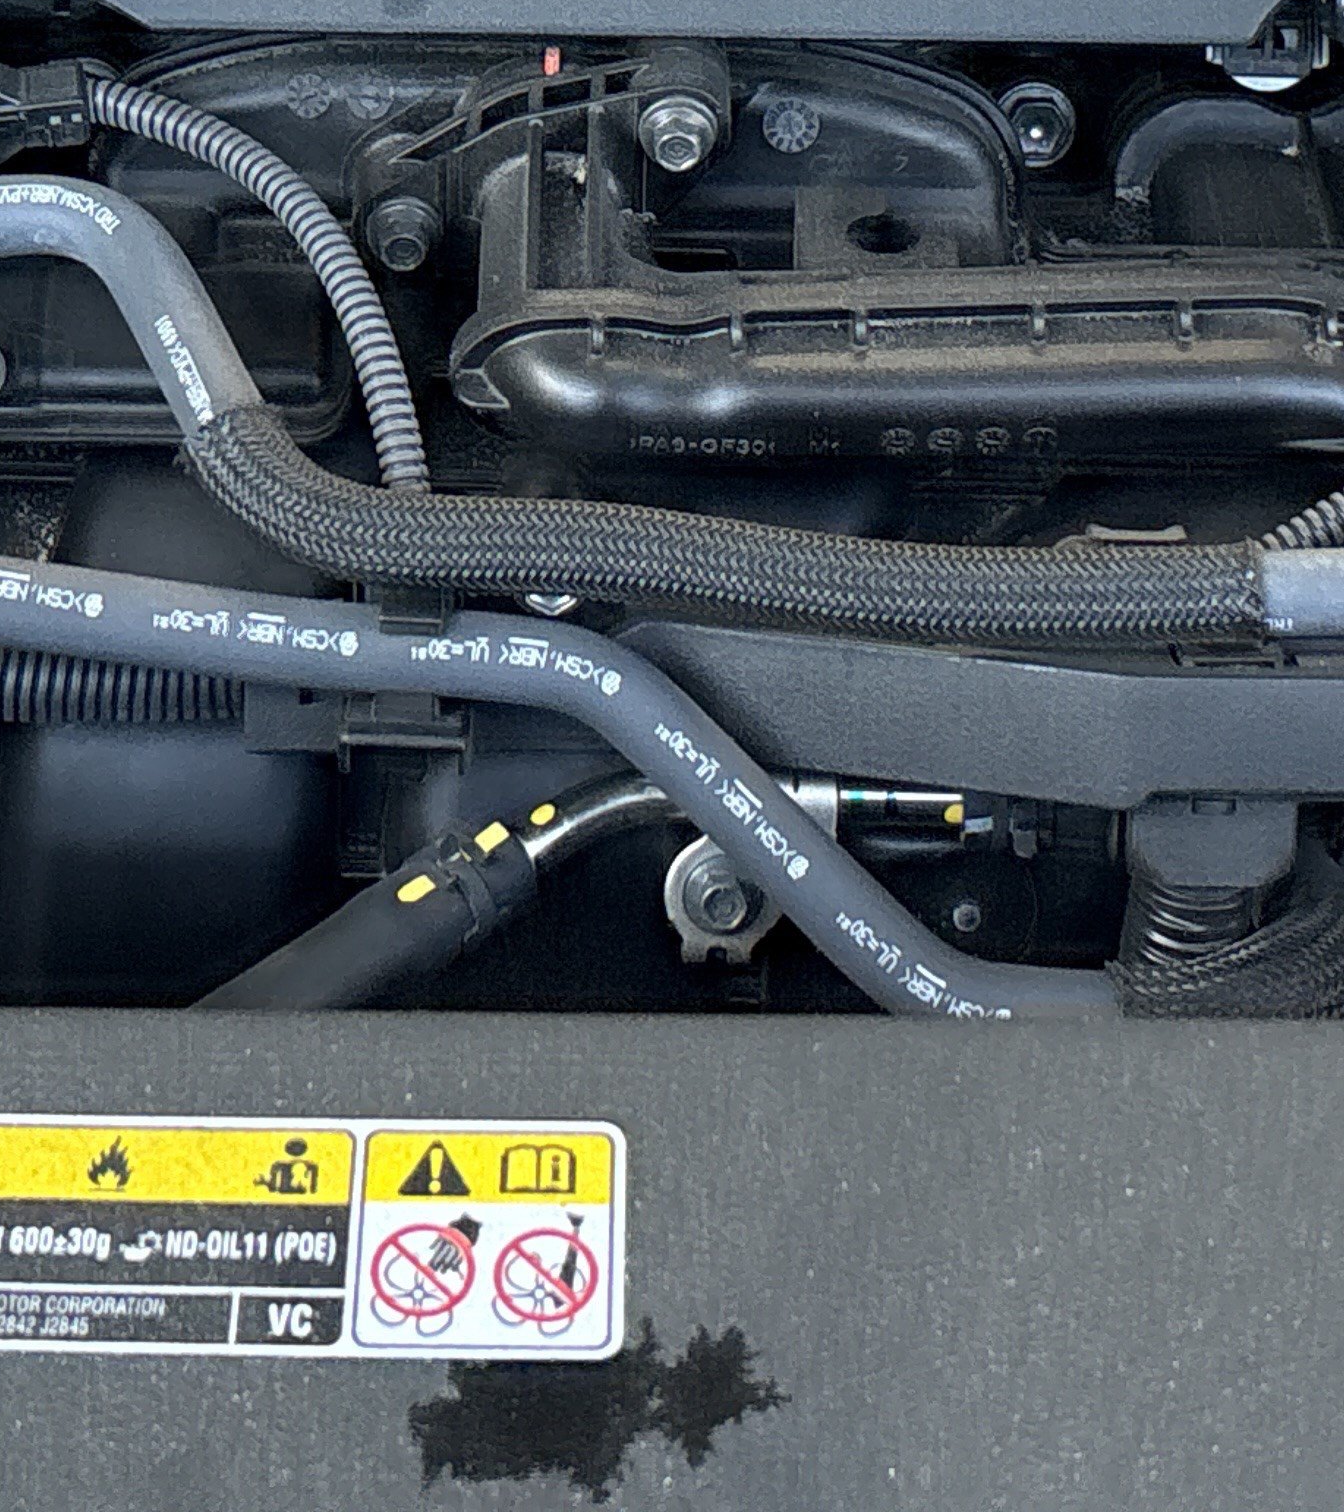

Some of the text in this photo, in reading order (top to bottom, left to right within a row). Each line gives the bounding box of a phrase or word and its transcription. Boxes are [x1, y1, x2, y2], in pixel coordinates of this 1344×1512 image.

[9, 1227, 111, 1260] 600±30g
[166, 1230, 267, 1261] ND-OIL11
[274, 1232, 336, 1265] (POE)
[45, 1296, 166, 1317] CORPORATION
[267, 1303, 313, 1337] VC
